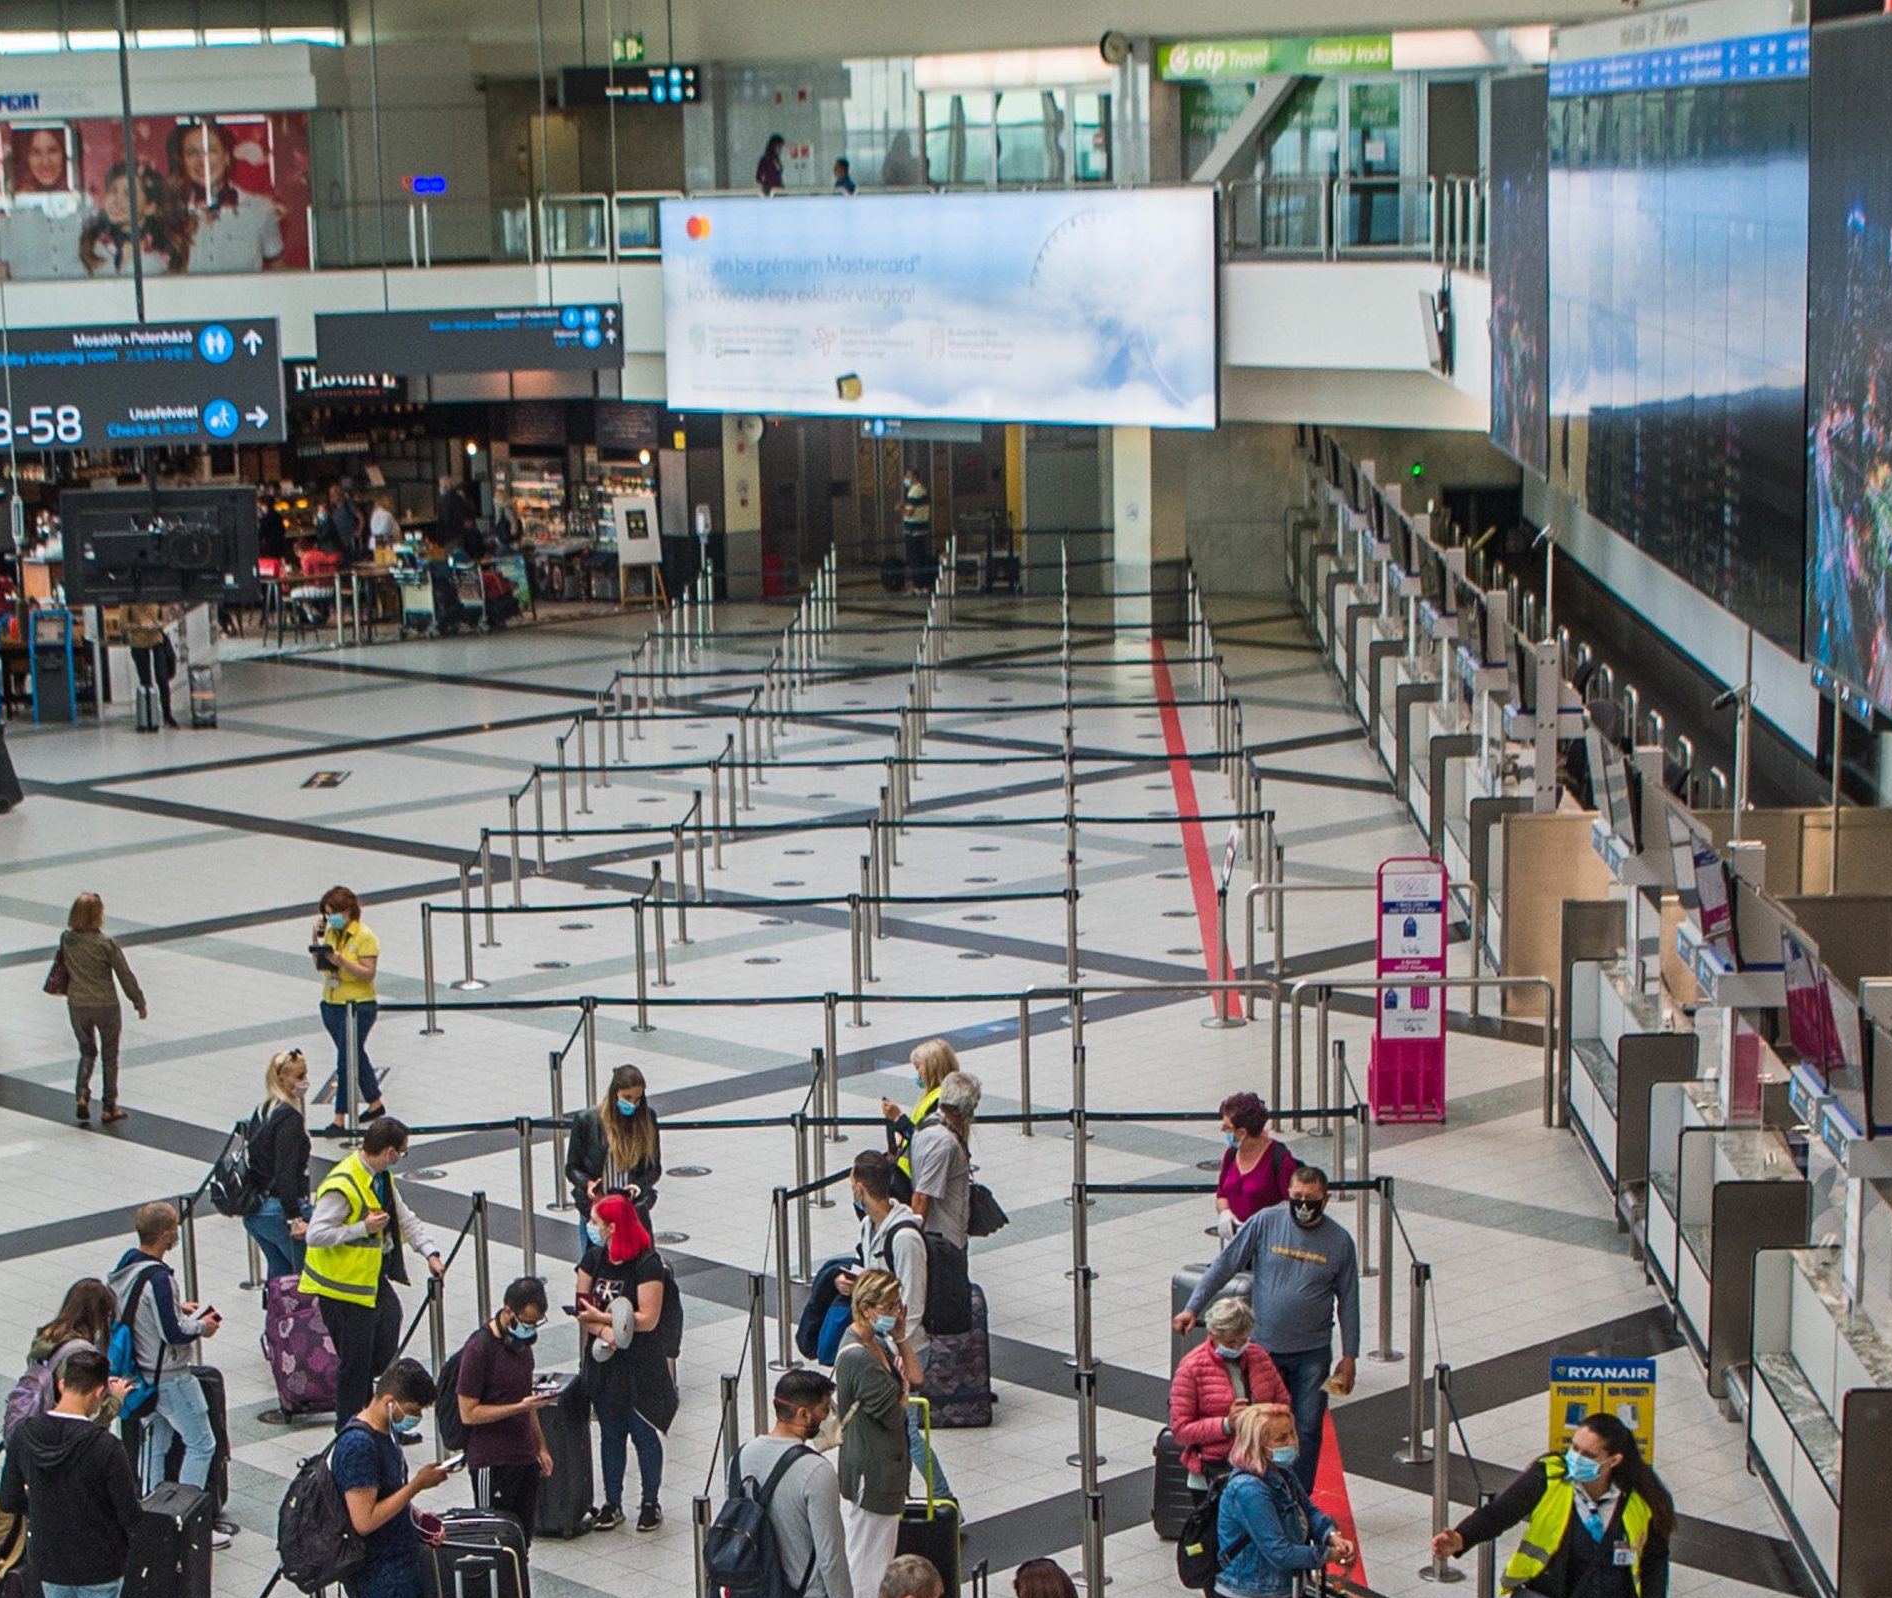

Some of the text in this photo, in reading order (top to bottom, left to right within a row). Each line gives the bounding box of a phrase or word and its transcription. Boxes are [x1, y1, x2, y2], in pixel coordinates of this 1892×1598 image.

[1193, 46, 1269, 75] otp Travel
[1355, 41, 1390, 64] Iroda
[1568, 1366, 1650, 1379] RYANAIR
